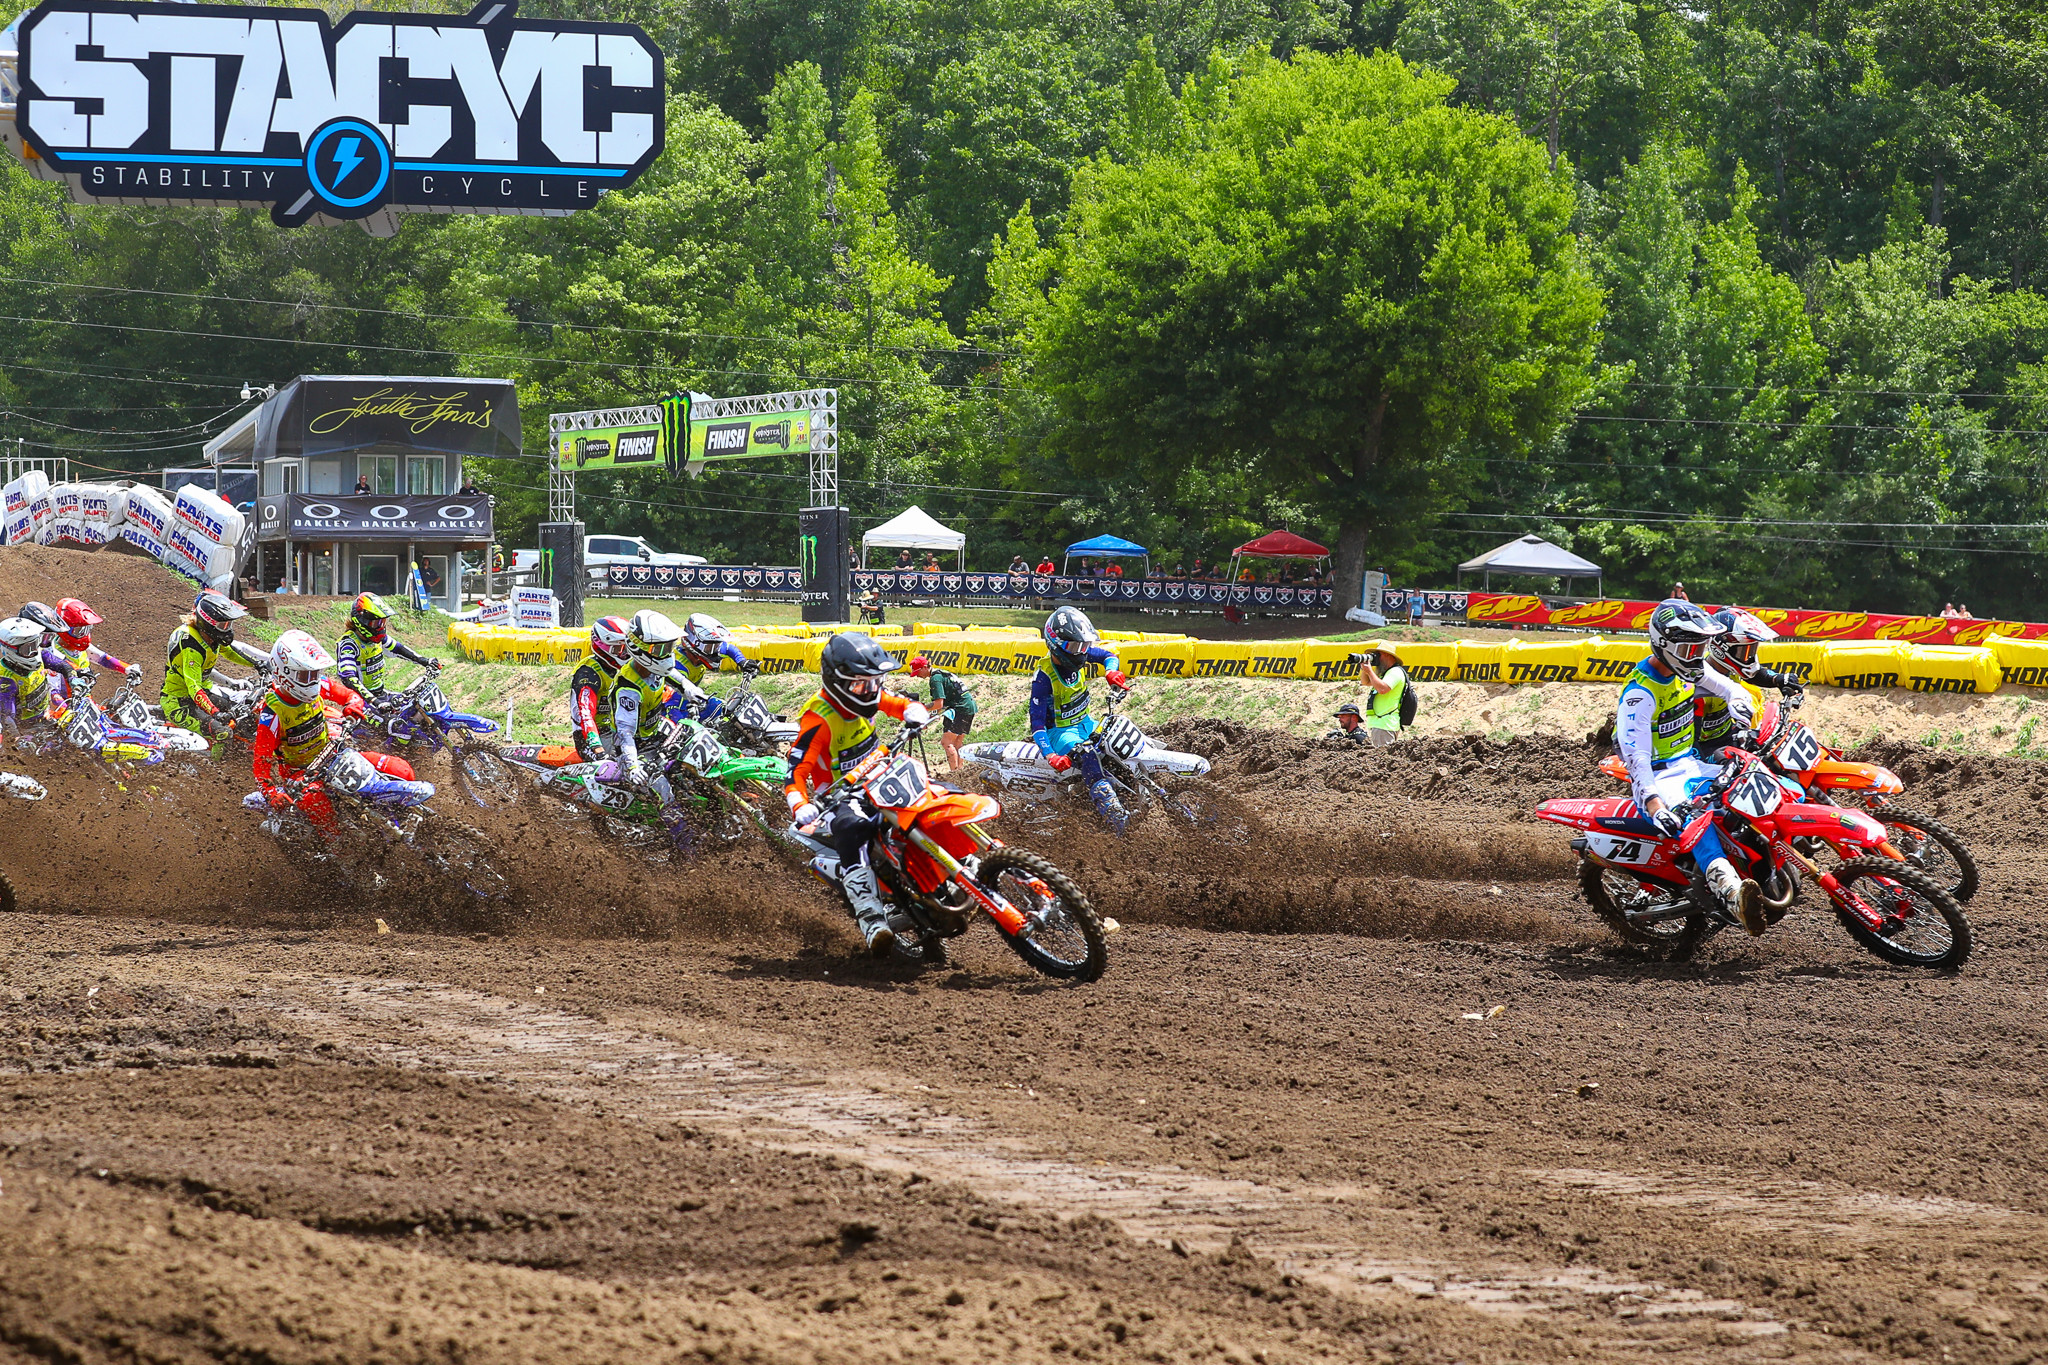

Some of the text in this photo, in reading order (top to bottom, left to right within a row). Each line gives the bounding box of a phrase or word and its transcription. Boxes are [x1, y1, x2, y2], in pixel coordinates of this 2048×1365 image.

[28, 11, 654, 165] STACYC
[92, 166, 587, 199] STABILITY CYCLE
[618, 436, 654, 457] FINISH
[707, 428, 746, 450] FINISH
[129, 499, 165, 532] PARTS
[177, 497, 224, 536] PARTS
[294, 519, 485, 528] OAKLEY OAKLEY OAKLEY
[123, 529, 163, 558] PARTS
[171, 530, 209, 566] PARTS
[518, 592, 550, 600] PARTS
[1469, 595, 1540, 619] FMF
[482, 604, 508, 615] PARTS
[521, 609, 552, 617] PARTS
[1551, 601, 1626, 624] FMF
[1797, 613, 1867, 636] FMF
[1876, 617, 1946, 640] FMF
[1956, 622, 2025, 645] FMF
[516, 652, 542, 665] THOR
[763, 658, 804, 672] THOR
[918, 650, 960, 668] THOR
[966, 653, 1011, 674] THOR
[1013, 653, 1041, 669] THO
[1127, 658, 1185, 675] THOR
[1196, 659, 1250, 676] THOR
[1253, 657, 1297, 674] THOR
[1585, 657, 1637, 678] THO
[1458, 662, 1500, 680] THOR
[1508, 662, 1578, 682] THOR
[1834, 672, 1899, 688] THOR
[1909, 676, 1977, 693] THOR
[424, 687, 447, 714] 72
[128, 701, 149, 728] 19
[744, 698, 768, 727] 87
[1625, 713, 1636, 748] FLY
[690, 733, 720, 778] 29
[1788, 729, 1819, 771] 15
[878, 761, 926, 808] 97
[1741, 773, 1778, 817] 74
[1606, 839, 1641, 862] 74
[1775, 842, 1810, 873] SHOWA
[957, 881, 997, 914] DUNLOP
[1835, 887, 1879, 921] DUNLOP
